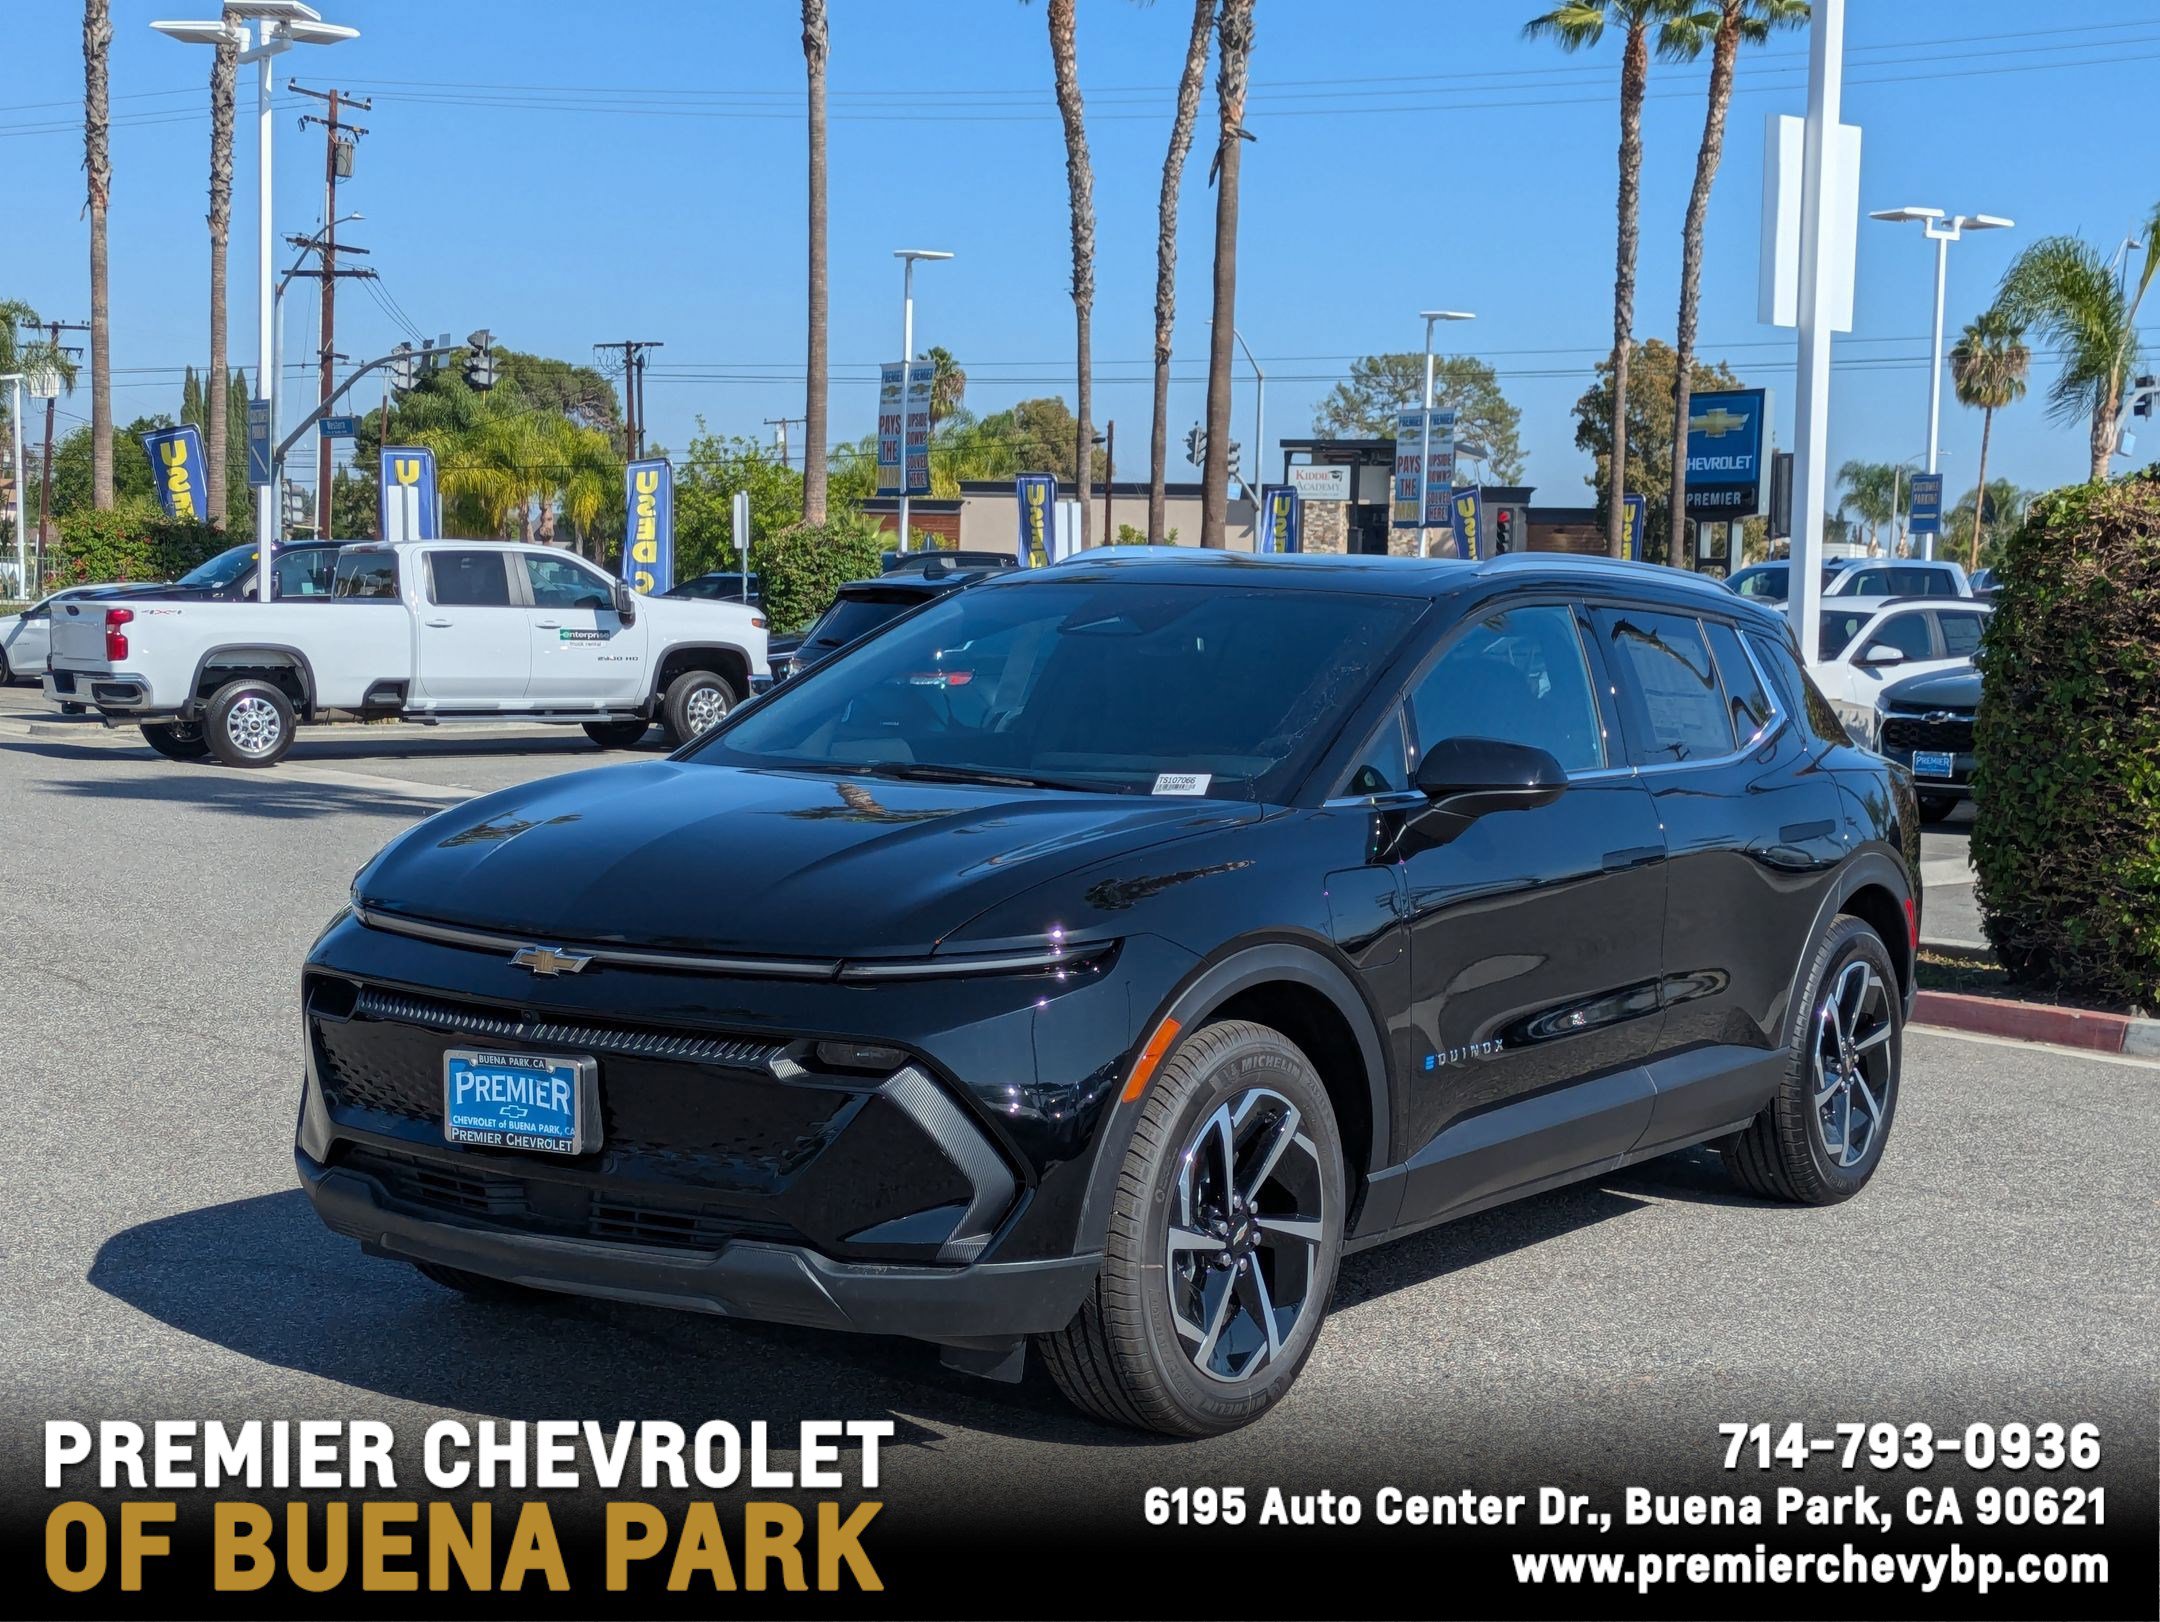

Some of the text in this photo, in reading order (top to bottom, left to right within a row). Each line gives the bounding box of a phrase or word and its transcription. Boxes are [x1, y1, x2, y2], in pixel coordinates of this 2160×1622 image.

[879, 415, 901, 435] PAYS
[908, 413, 928, 427] UPSIDE
[882, 440, 897, 461] THE
[1397, 456, 1421, 474] PAYS
[1686, 455, 1752, 471] HEVROLET
[1400, 479, 1416, 496] THE
[1686, 491, 1741, 506] PREMIER
[560, 630, 610, 640] enterprise
[478, 1054, 507, 1065] BUENA
[1241, 1054, 1304, 1081] MICHELIN
[455, 1071, 572, 1116] PREMIER
[452, 1115, 576, 1136] CHEVROLET of BUENA PARK, CA
[451, 1127, 573, 1152] PREMIER CHEVROLET
